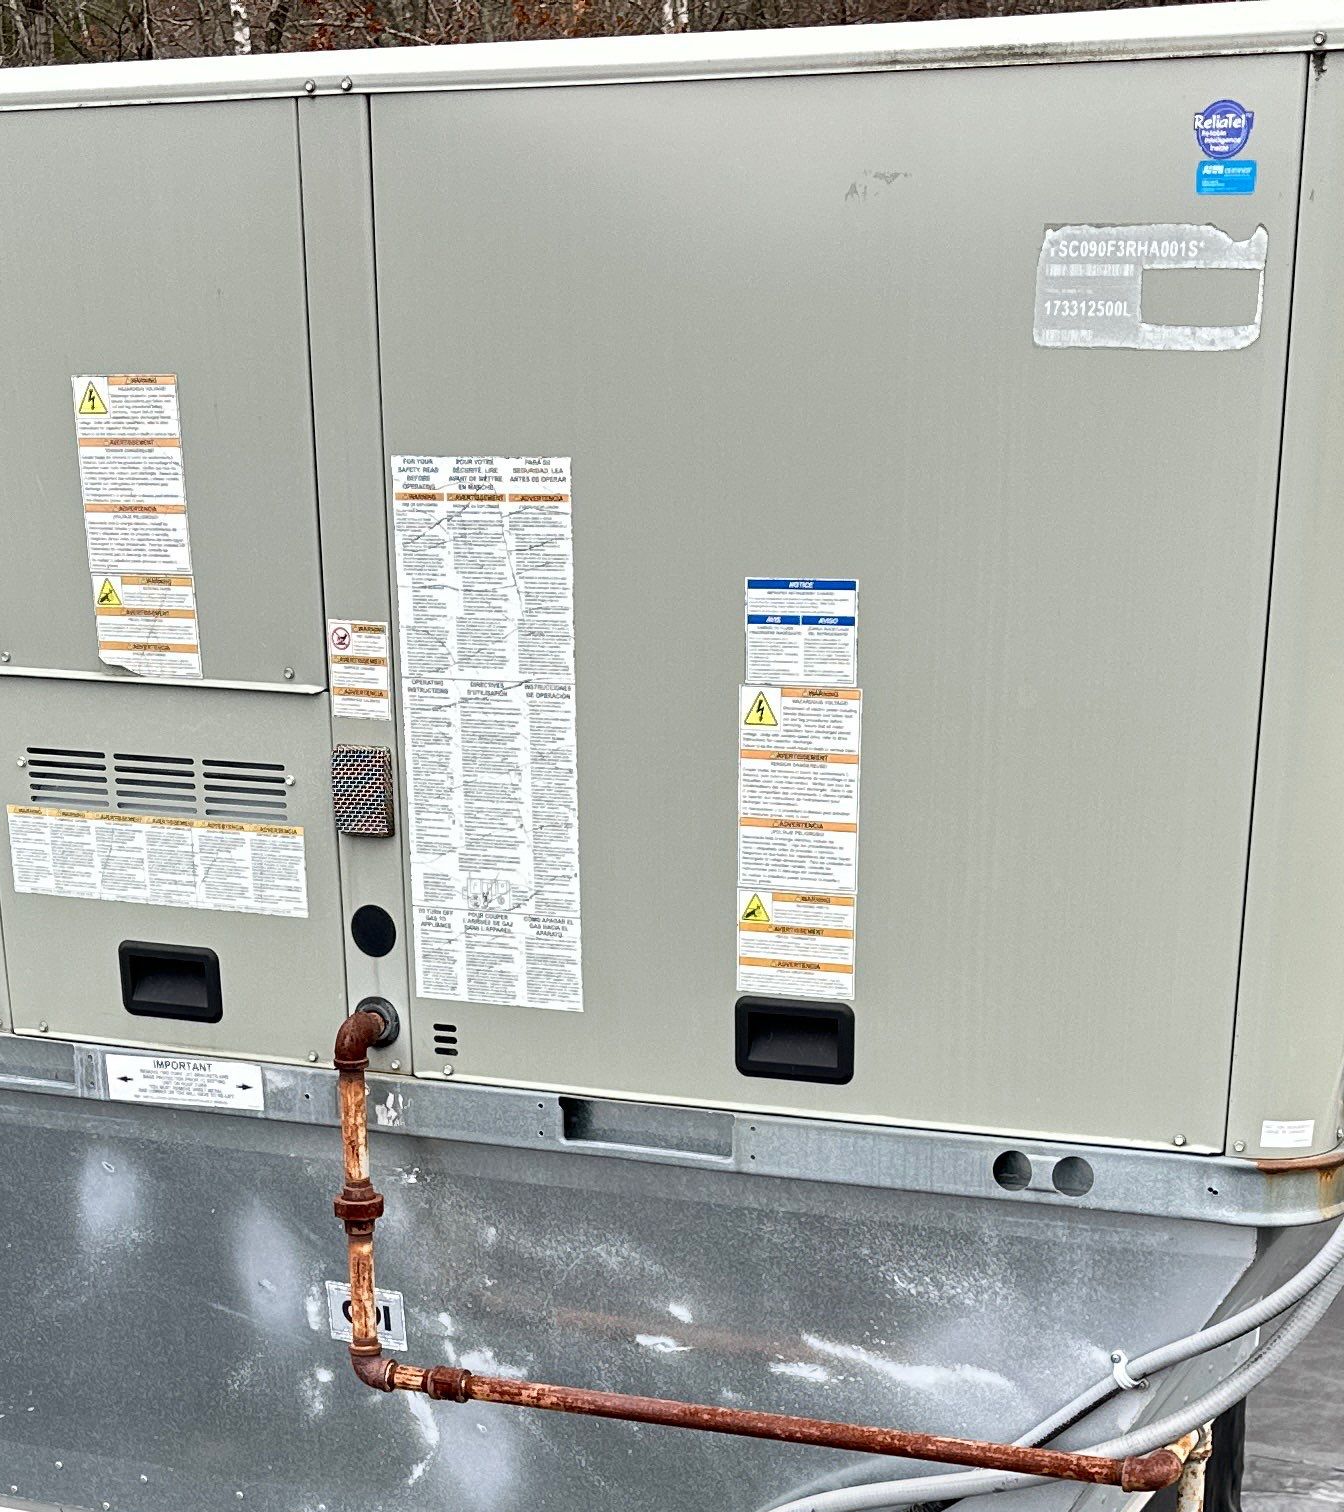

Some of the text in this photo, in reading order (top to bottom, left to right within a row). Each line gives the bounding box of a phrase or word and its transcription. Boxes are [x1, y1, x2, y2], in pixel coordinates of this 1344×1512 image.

[1194, 113, 1246, 129] ReliaTel
[1044, 299, 1131, 317] 173312500L
[153, 1060, 213, 1073] IMPORTANT
